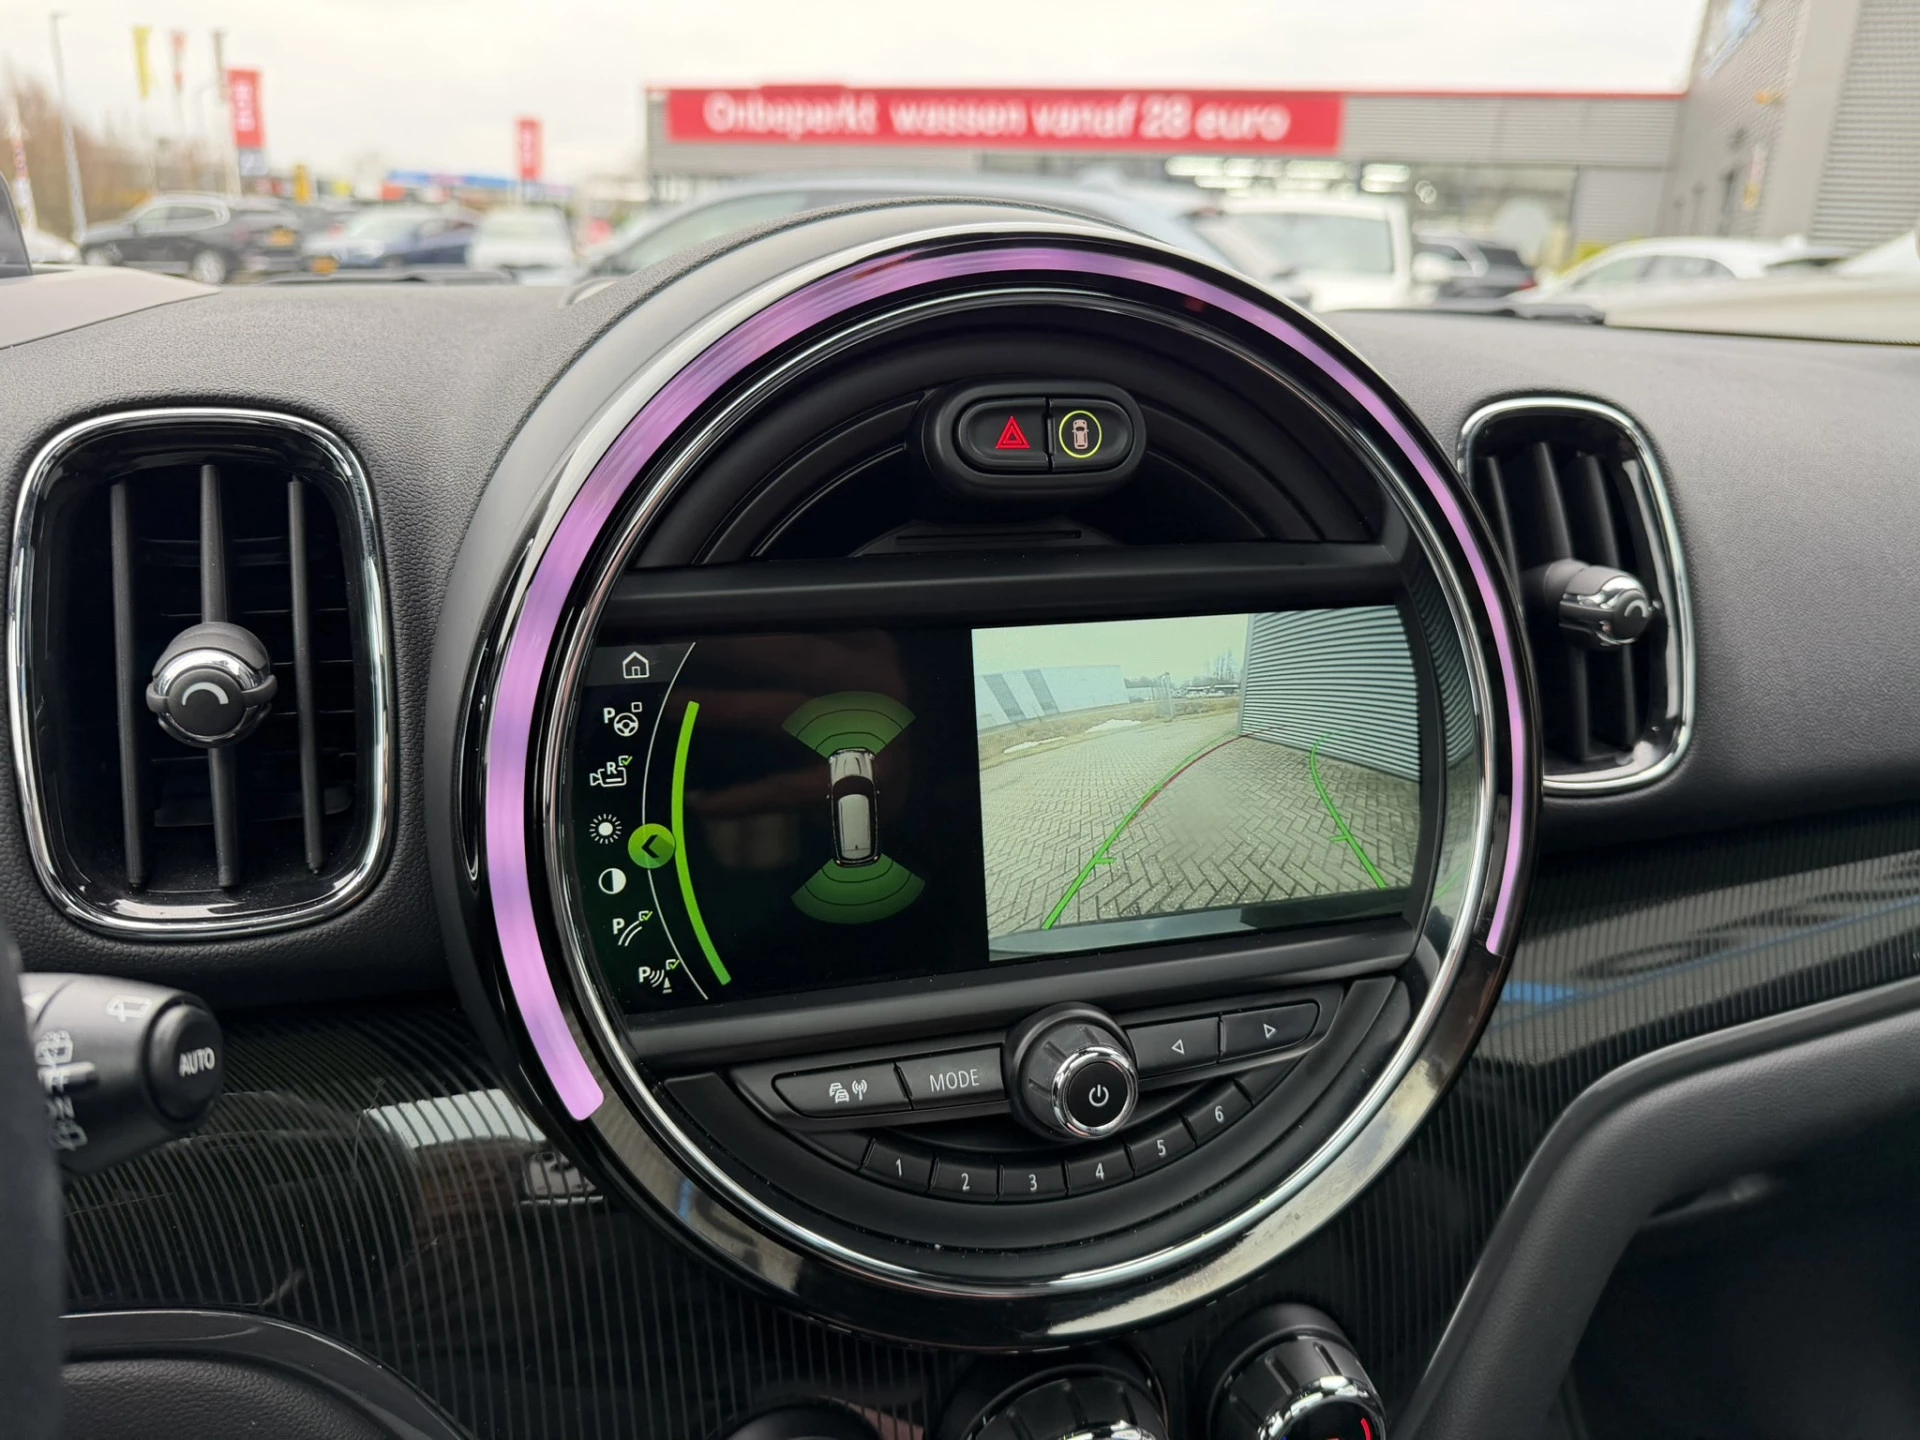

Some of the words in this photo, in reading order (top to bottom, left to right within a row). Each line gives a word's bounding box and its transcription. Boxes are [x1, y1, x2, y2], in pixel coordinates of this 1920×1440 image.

[889, 99, 1027, 136] wassen
[1031, 94, 1140, 139] vanaf
[1139, 94, 1193, 140] 28
[1195, 102, 1291, 141] euro
[179, 1046, 215, 1077] AUTO
[929, 1068, 980, 1092] MODE
[1214, 1105, 1225, 1123] 6
[1156, 1139, 1167, 1156] 5
[895, 1158, 903, 1178] 1
[1095, 1162, 1105, 1180] 4
[961, 1172, 971, 1192] 2
[1028, 1173, 1038, 1192] 3
